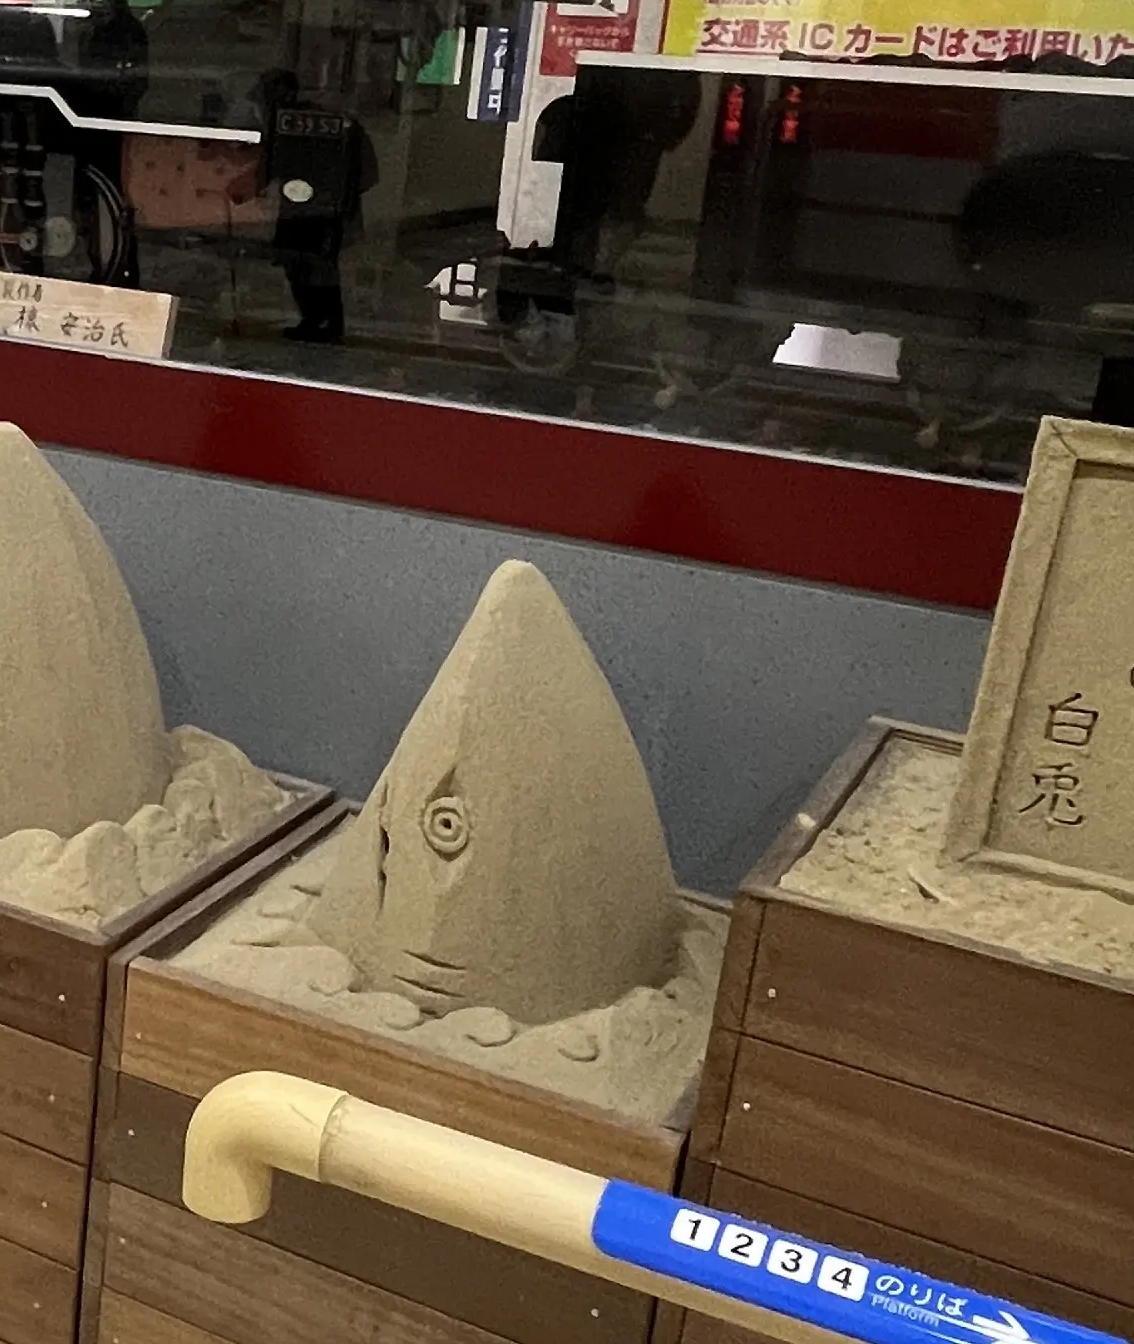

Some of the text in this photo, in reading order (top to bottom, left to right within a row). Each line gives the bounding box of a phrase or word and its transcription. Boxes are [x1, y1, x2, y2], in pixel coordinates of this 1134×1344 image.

[687, 1218, 968, 1316] 1 2 3 4 のりば
[869, 1293, 940, 1327] Platform
